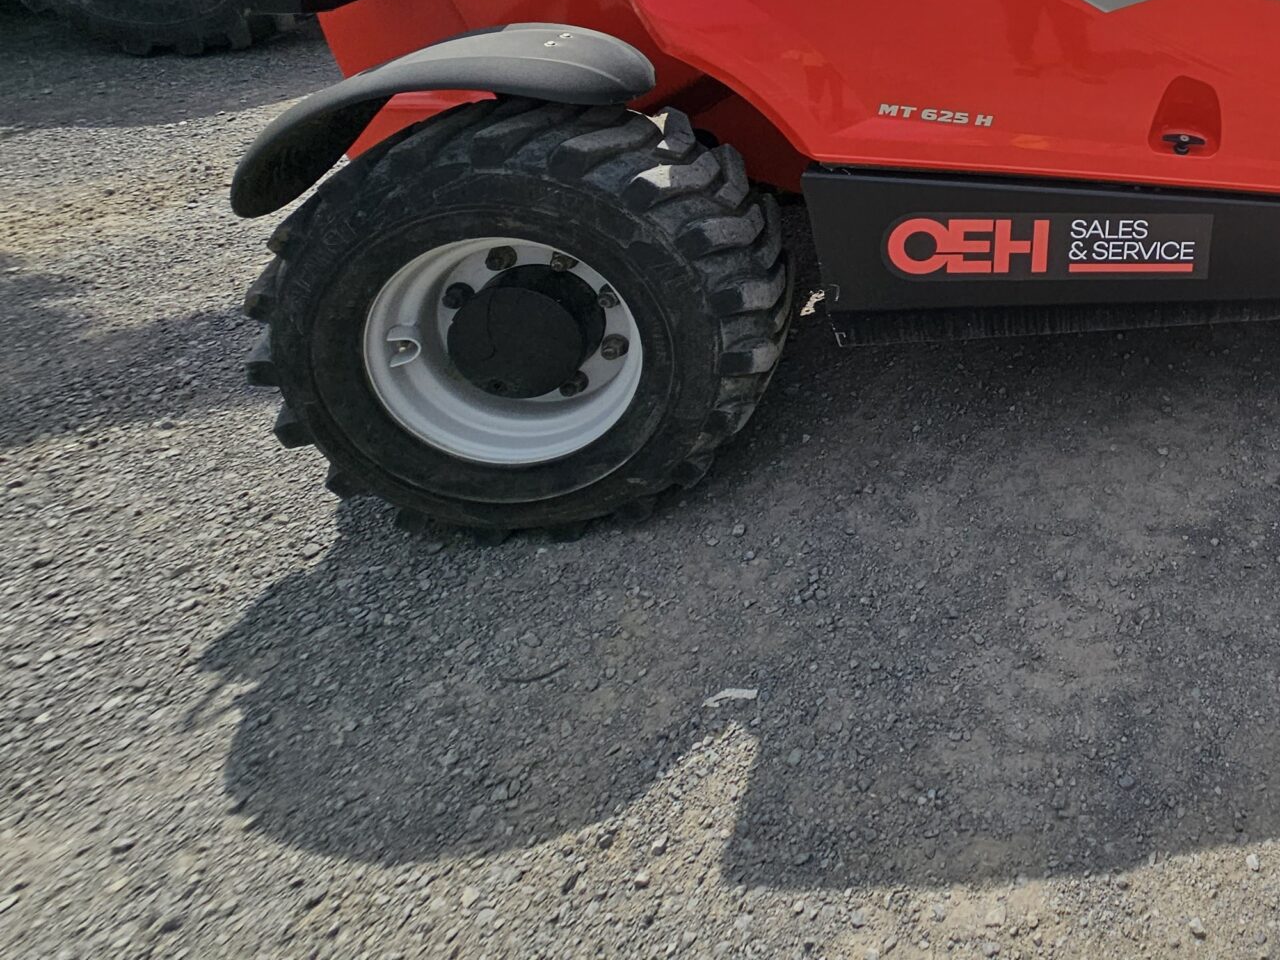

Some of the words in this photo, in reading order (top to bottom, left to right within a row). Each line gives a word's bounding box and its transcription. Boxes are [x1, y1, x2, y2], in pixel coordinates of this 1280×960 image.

[878, 103, 917, 119] MT
[920, 107, 970, 124] 625
[974, 113, 994, 127] H
[1069, 219, 1148, 239] SALES
[886, 218, 1050, 274] OEH
[1068, 241, 1088, 261] &
[1092, 241, 1195, 261] SERVICE
